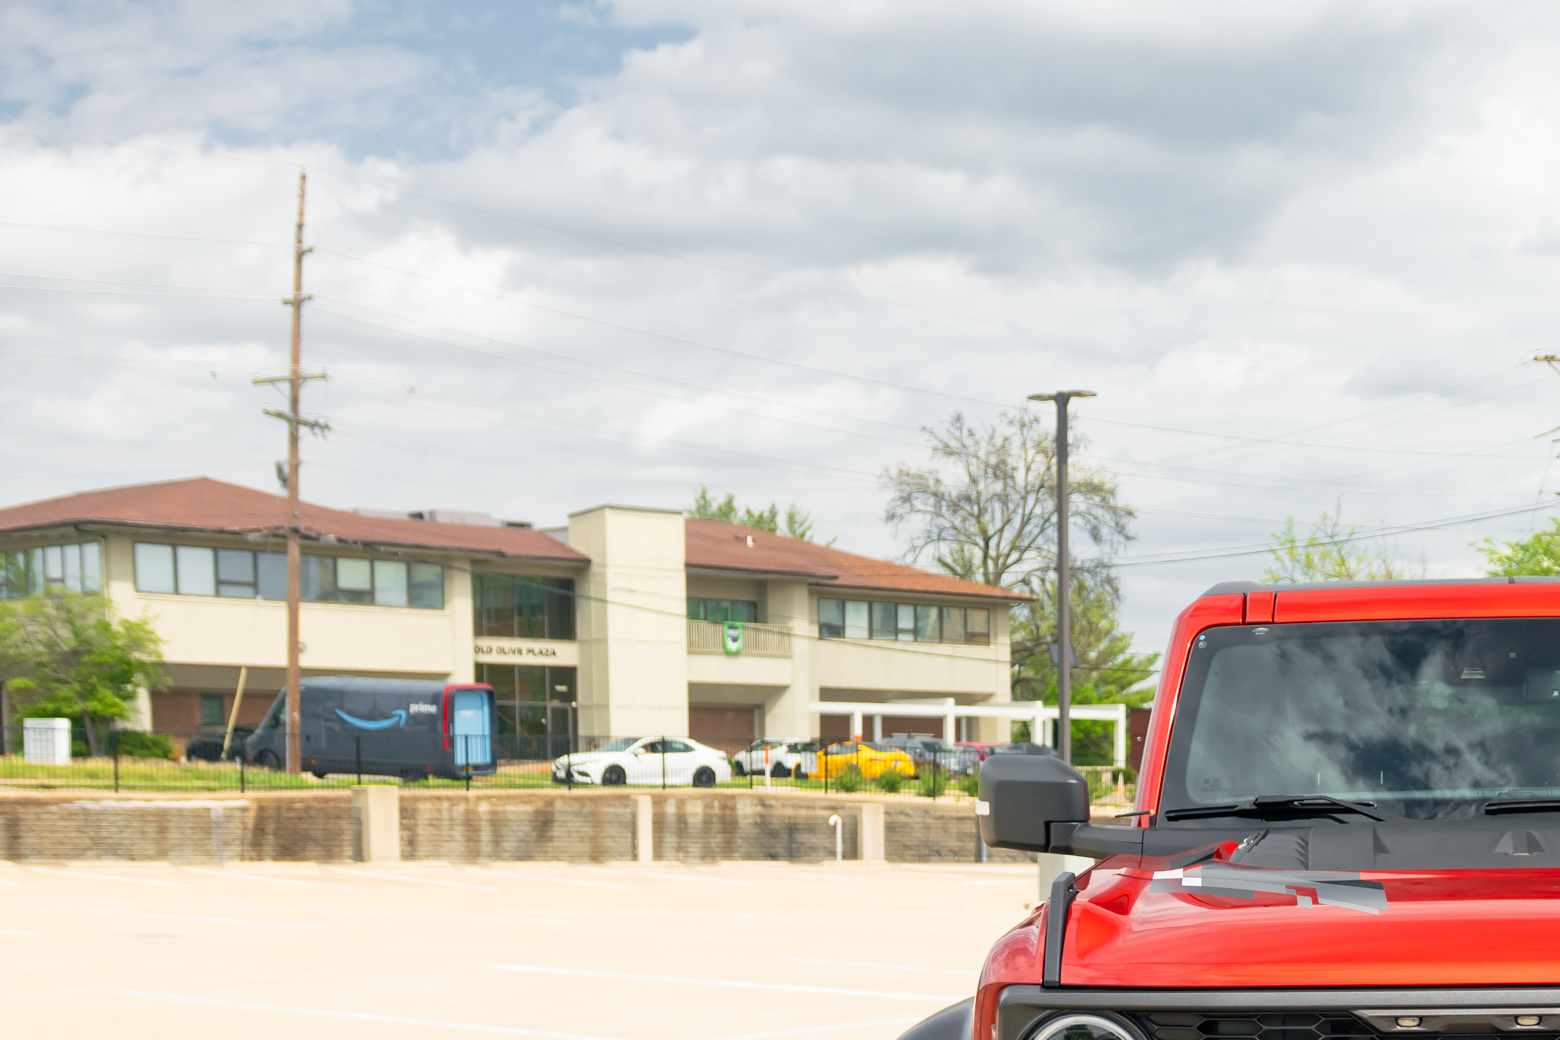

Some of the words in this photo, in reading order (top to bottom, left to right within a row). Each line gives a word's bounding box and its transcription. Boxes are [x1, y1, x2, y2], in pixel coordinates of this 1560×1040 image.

[474, 645, 493, 655] OLD
[496, 646, 523, 656] OLIVE
[526, 647, 557, 657] PLAZA
[409, 701, 437, 715] prime
